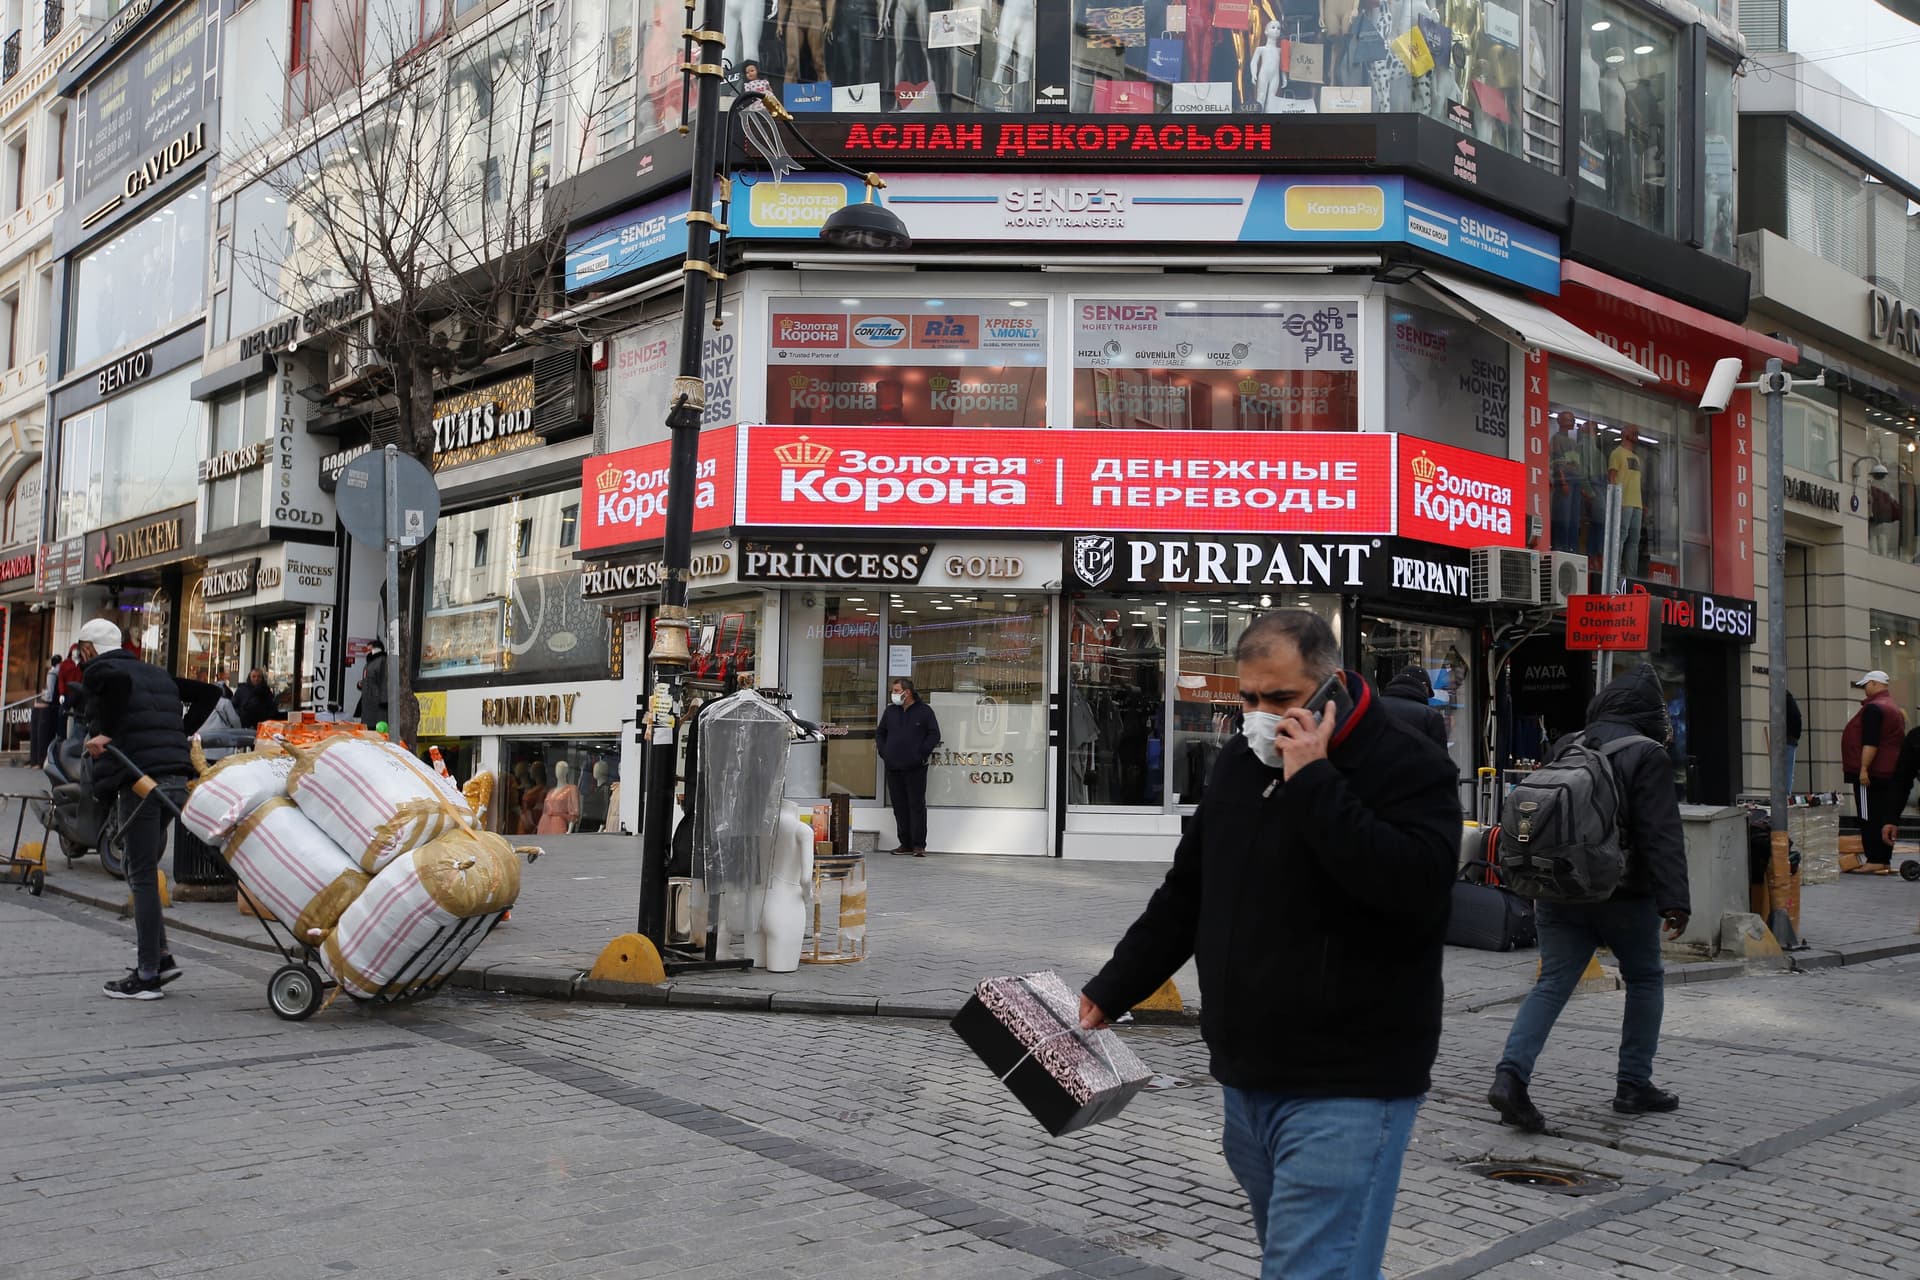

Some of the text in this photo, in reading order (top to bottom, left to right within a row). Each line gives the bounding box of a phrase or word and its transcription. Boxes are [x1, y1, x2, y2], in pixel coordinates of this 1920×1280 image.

[720, 73, 740, 84] ALE
[1175, 104, 1231, 112] COSMO BELLA
[845, 124, 1272, 156] АСЛАН ДЕКОРАСЬОН
[125, 121, 204, 198] GAVIOLI
[779, 192, 838, 206] Золотая
[1005, 187, 1125, 213] SENDER
[1307, 201, 1379, 217] KoronaPay
[620, 215, 666, 245] SENDER
[1005, 217, 1125, 228] MONEY TRANSFER
[1460, 216, 1509, 249] SENDER
[639, 234, 666, 250] TRANSFER
[1481, 241, 1509, 259] TRANSFER
[984, 319, 1033, 329] XPRESS
[1082, 305, 1158, 321] SENDER
[781, 328, 838, 343] Корона
[793, 321, 838, 331] Золотая
[925, 316, 965, 336] Ria
[996, 328, 1040, 338] MONEY
[1082, 323, 1158, 331] MONEY TRANSFER
[702, 334, 734, 359] END
[1396, 324, 1447, 352] SENDER
[619, 340, 668, 370] SENDER
[701, 354, 734, 379] NEY
[1152, 359, 1186, 367] RELIABLE
[1207, 352, 1230, 360] UCUZ
[1216, 359, 1242, 367] CHEAP
[98, 352, 147, 396] BENTO
[1471, 359, 1506, 383] SEND
[705, 376, 734, 402] PAY
[810, 378, 878, 392] Золотая
[951, 379, 1018, 393] Золотая
[1118, 381, 1186, 396] Золотая
[1260, 383, 1329, 398] Золотая
[1459, 374, 1507, 402] MONEY
[703, 400, 731, 425] ESS
[790, 389, 877, 413] Корона
[930, 390, 1018, 414] Корона
[1098, 394, 1185, 417] Корона
[1240, 394, 1329, 418] Корона
[1482, 398, 1507, 420] PAY
[499, 408, 532, 437] GOLD
[1475, 415, 1506, 438] LESS
[838, 450, 1027, 475] Золотая
[1091, 459, 1358, 481] ДЕНЕЖНЫЕ
[622, 458, 716, 493] Золая
[1436, 466, 1512, 506] Золотая
[1736, 412, 1747, 561] export
[780, 469, 1027, 512] Корона
[1092, 486, 1356, 513] ПЕРЕВОДЫ
[597, 481, 715, 526] Короа
[1414, 482, 1512, 535] Корона
[275, 508, 324, 526] GOLD
[115, 518, 182, 563] DAKKEM
[0, 554, 32, 581] XANDRA
[691, 554, 726, 577] OLD
[944, 555, 1025, 579] GOLD
[1088, 551, 1101, 570] P
[1127, 541, 1371, 586] PERPANT
[256, 567, 280, 588] GOLD
[298, 576, 322, 586] GOLD
[1391, 556, 1470, 597] PERPANT
[1585, 601, 1626, 612] Dikkat
[1702, 596, 1752, 636] Bessi
[1579, 617, 1637, 628] Otomatik
[1572, 632, 1641, 643] Bariyer Var
[1525, 665, 1567, 679] AYATA
[968, 771, 1014, 784] GOLD
